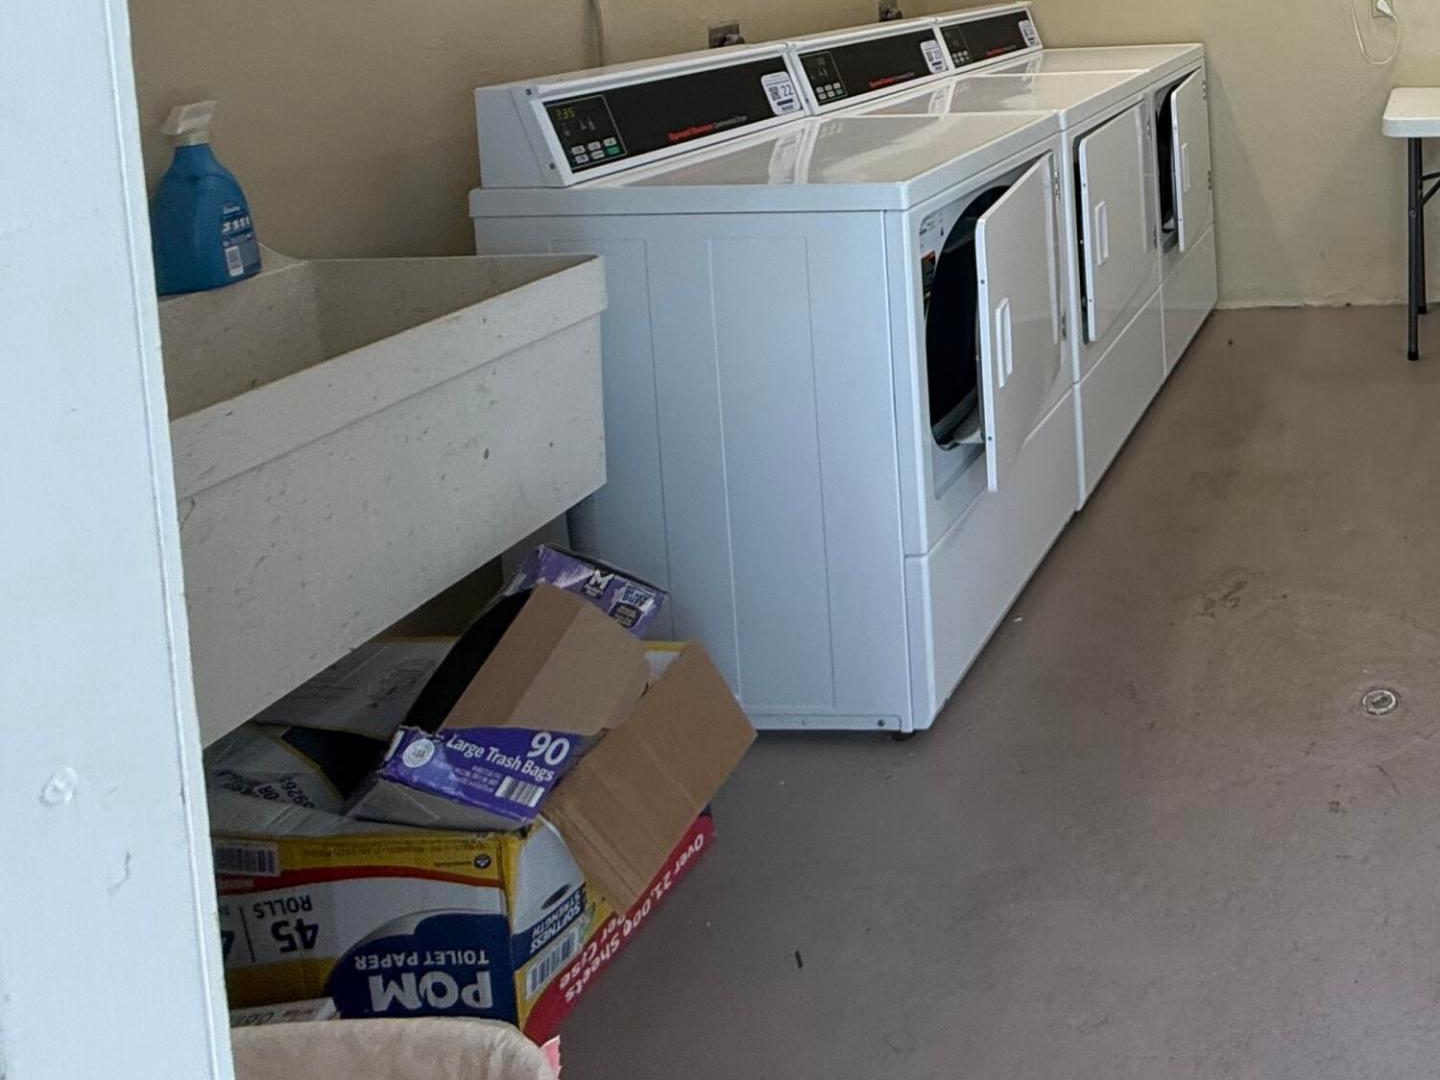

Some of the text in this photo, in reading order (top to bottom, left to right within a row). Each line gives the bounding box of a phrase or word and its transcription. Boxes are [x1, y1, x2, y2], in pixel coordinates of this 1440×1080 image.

[780, 83, 794, 97] 22
[446, 734, 486, 758] Large
[485, 746, 522, 771] Trash
[520, 759, 555, 783] Bags
[526, 731, 571, 766] 90
[252, 895, 313, 919] ROLLS
[564, 832, 705, 1003] Over 21,000 Sheets
[270, 917, 320, 954] 45
[353, 949, 489, 970] TOILET PAPER
[367, 970, 495, 1013] POM
